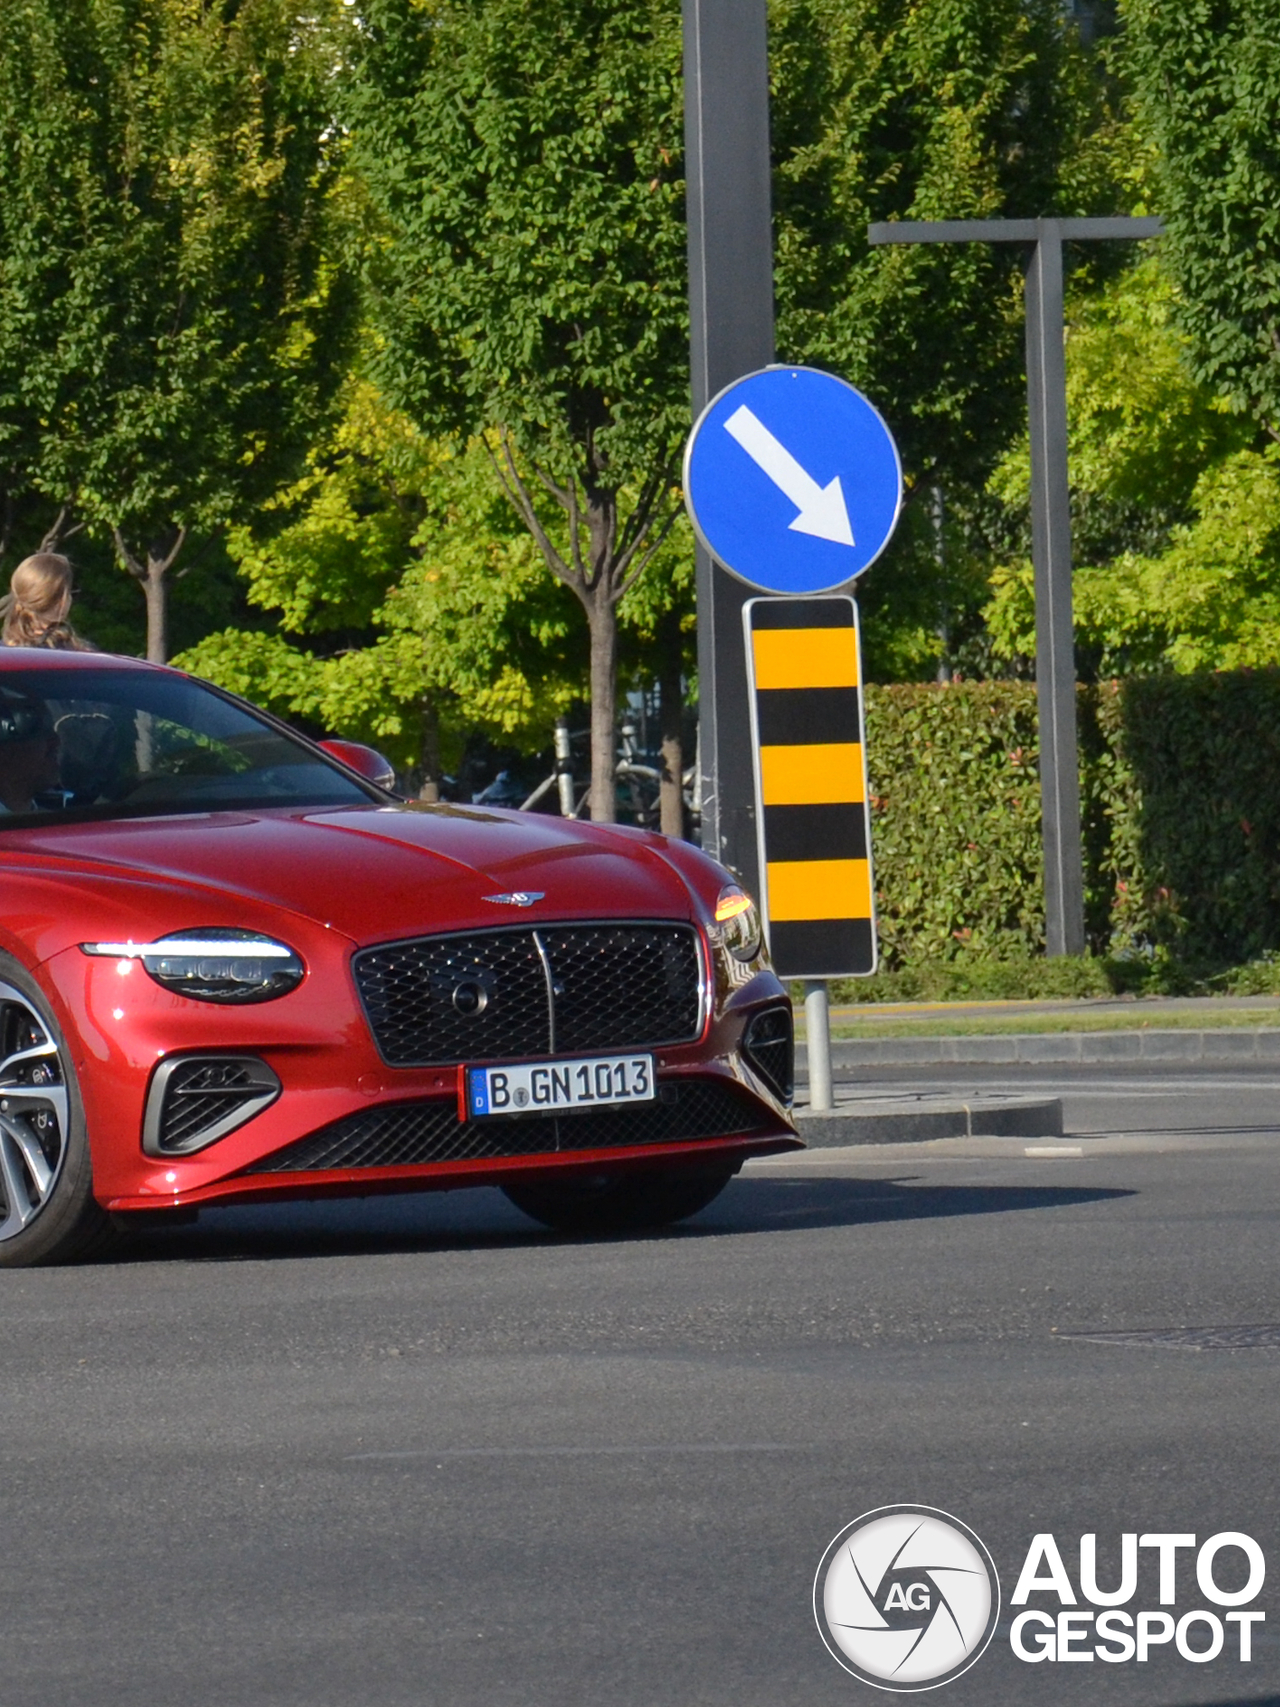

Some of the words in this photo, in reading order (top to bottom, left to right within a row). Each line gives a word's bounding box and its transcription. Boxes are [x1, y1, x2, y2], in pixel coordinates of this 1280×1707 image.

[490, 1073, 510, 1108] B
[531, 1067, 570, 1104] GN
[576, 1060, 648, 1101] 1013
[475, 1096, 484, 1108] D
